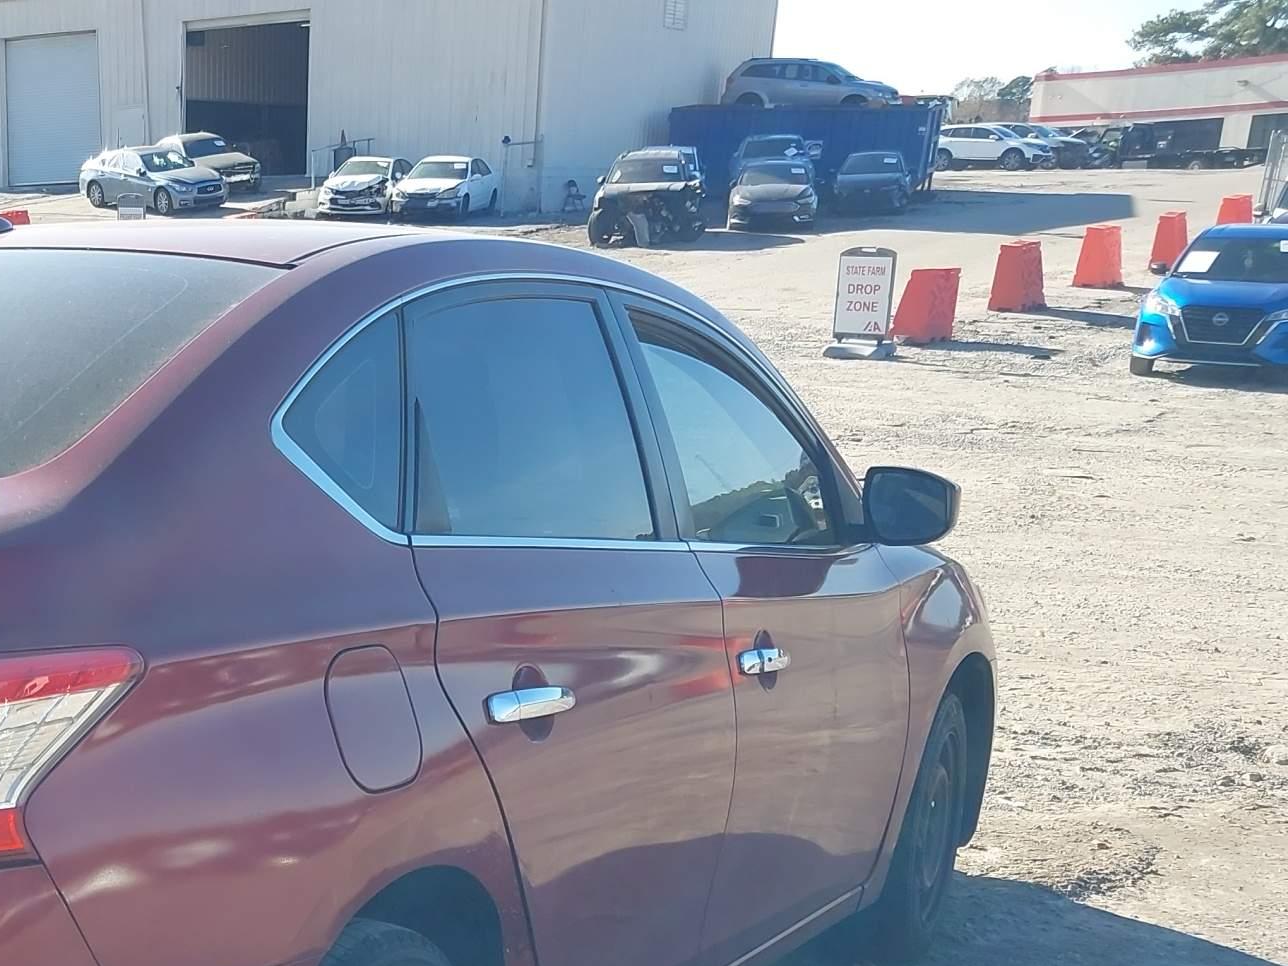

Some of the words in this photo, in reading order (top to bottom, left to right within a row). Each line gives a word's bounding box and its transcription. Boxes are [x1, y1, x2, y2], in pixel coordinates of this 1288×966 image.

[846, 266, 866, 276] STATE
[868, 266, 886, 276] FARM
[848, 284, 881, 295] DROP
[846, 301, 879, 312] ZONE
